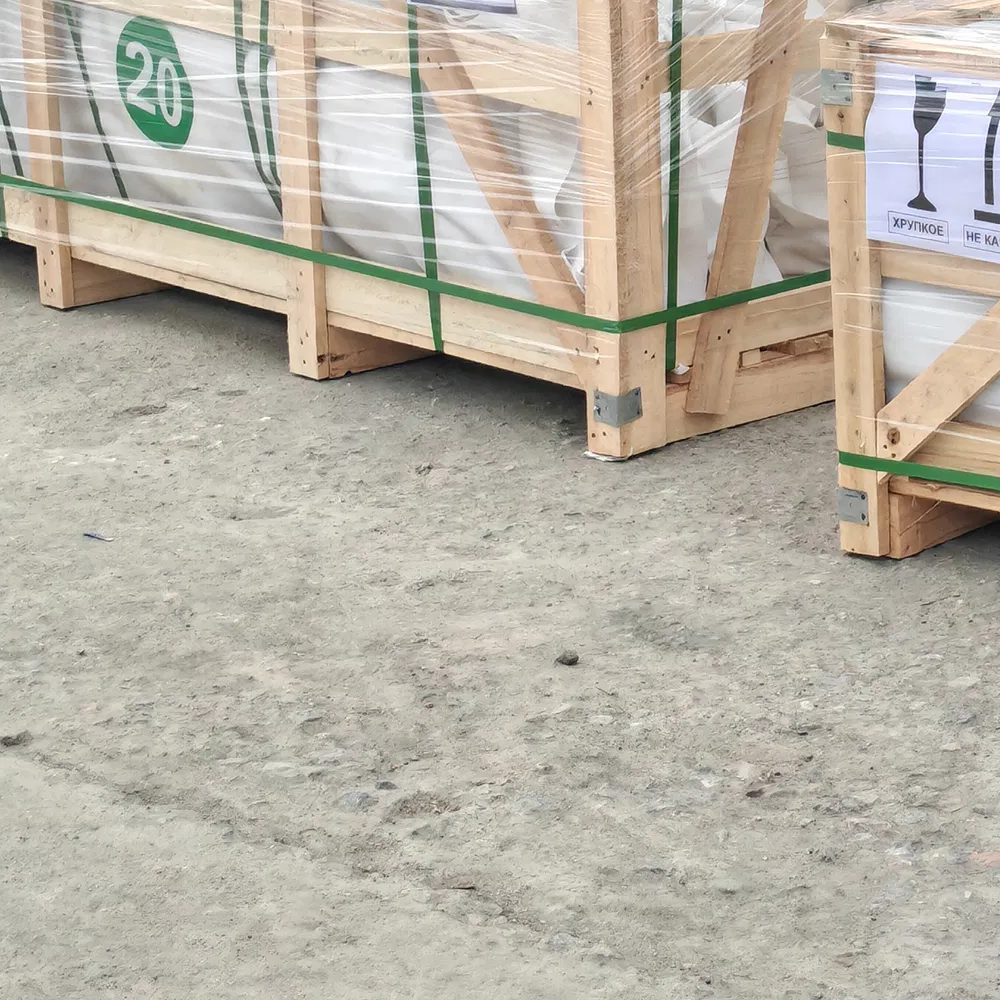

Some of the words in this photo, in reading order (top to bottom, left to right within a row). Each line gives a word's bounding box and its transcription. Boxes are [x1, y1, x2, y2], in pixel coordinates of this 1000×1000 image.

[125, 41, 183, 127] 20
[893, 216, 944, 236] ХРУПКОЕ
[966, 231, 981, 244] НЕ
